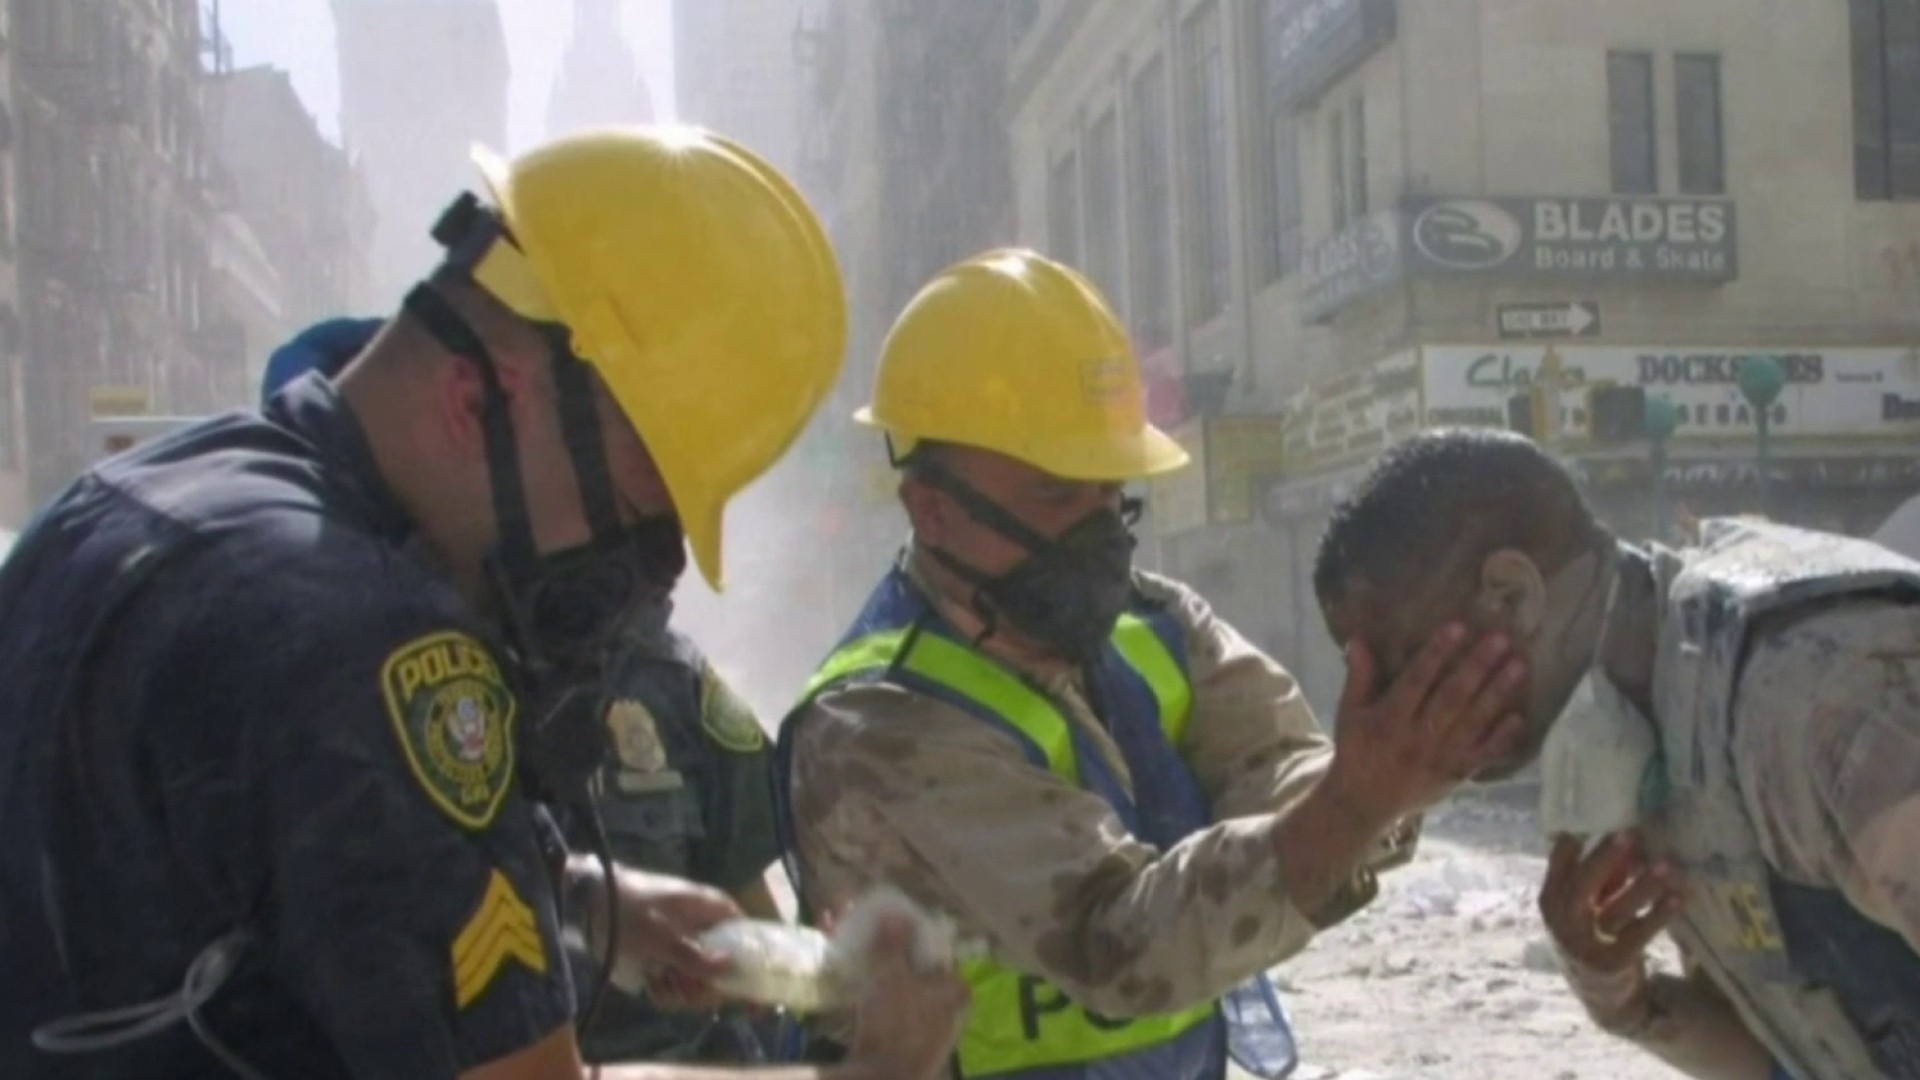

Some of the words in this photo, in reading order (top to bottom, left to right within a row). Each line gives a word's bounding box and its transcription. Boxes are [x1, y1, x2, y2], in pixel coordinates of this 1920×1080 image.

[1534, 202, 1726, 243] BLADES
[1535, 246, 1615, 271] Board
[1626, 246, 1644, 270] &
[1656, 247, 1726, 271] Skate
